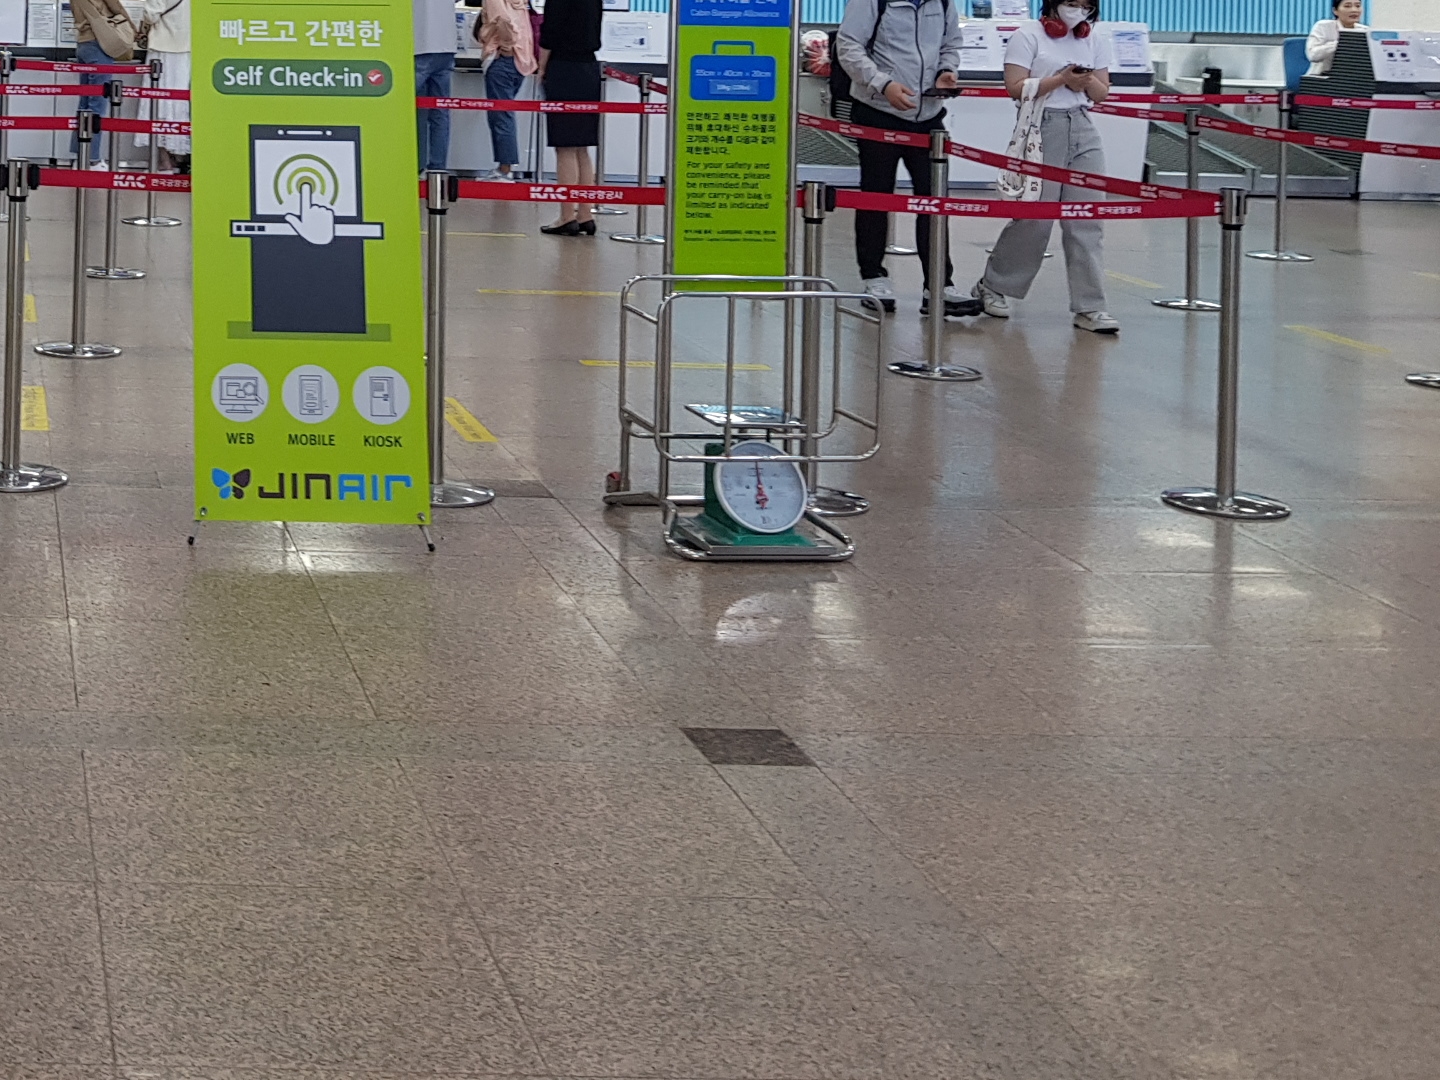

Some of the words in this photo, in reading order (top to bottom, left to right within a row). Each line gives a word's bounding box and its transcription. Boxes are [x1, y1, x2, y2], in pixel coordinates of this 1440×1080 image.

[219, 19, 298, 46] 빠르고
[305, 19, 383, 47] 간편한
[223, 66, 264, 86] Self
[269, 66, 363, 87] Check-in
[5, 85, 29, 94] KAC
[436, 98, 460, 108] KAC
[540, 102, 564, 111] KAC
[151, 122, 180, 133] KAC
[686, 161, 701, 169] For
[703, 162, 723, 170] your
[725, 161, 752, 170] safety
[753, 162, 770, 170] and
[113, 174, 147, 188] KAC
[743, 172, 771, 180] please
[686, 181, 697, 189] be
[698, 181, 740, 189] reminded
[741, 181, 759, 189] that
[529, 186, 568, 200] KAC
[569, 189, 624, 200] 한국공항공사
[686, 192, 706, 200] your
[707, 192, 745, 200] carry-on
[746, 192, 762, 200] bag
[686, 201, 716, 209] limited
[729, 201, 770, 210] indicated
[907, 198, 941, 212] KAC
[1061, 204, 1094, 217] KAC
[226, 432, 255, 445] WEB
[288, 433, 336, 446] MOBILE
[363, 435, 403, 448] KIOSK
